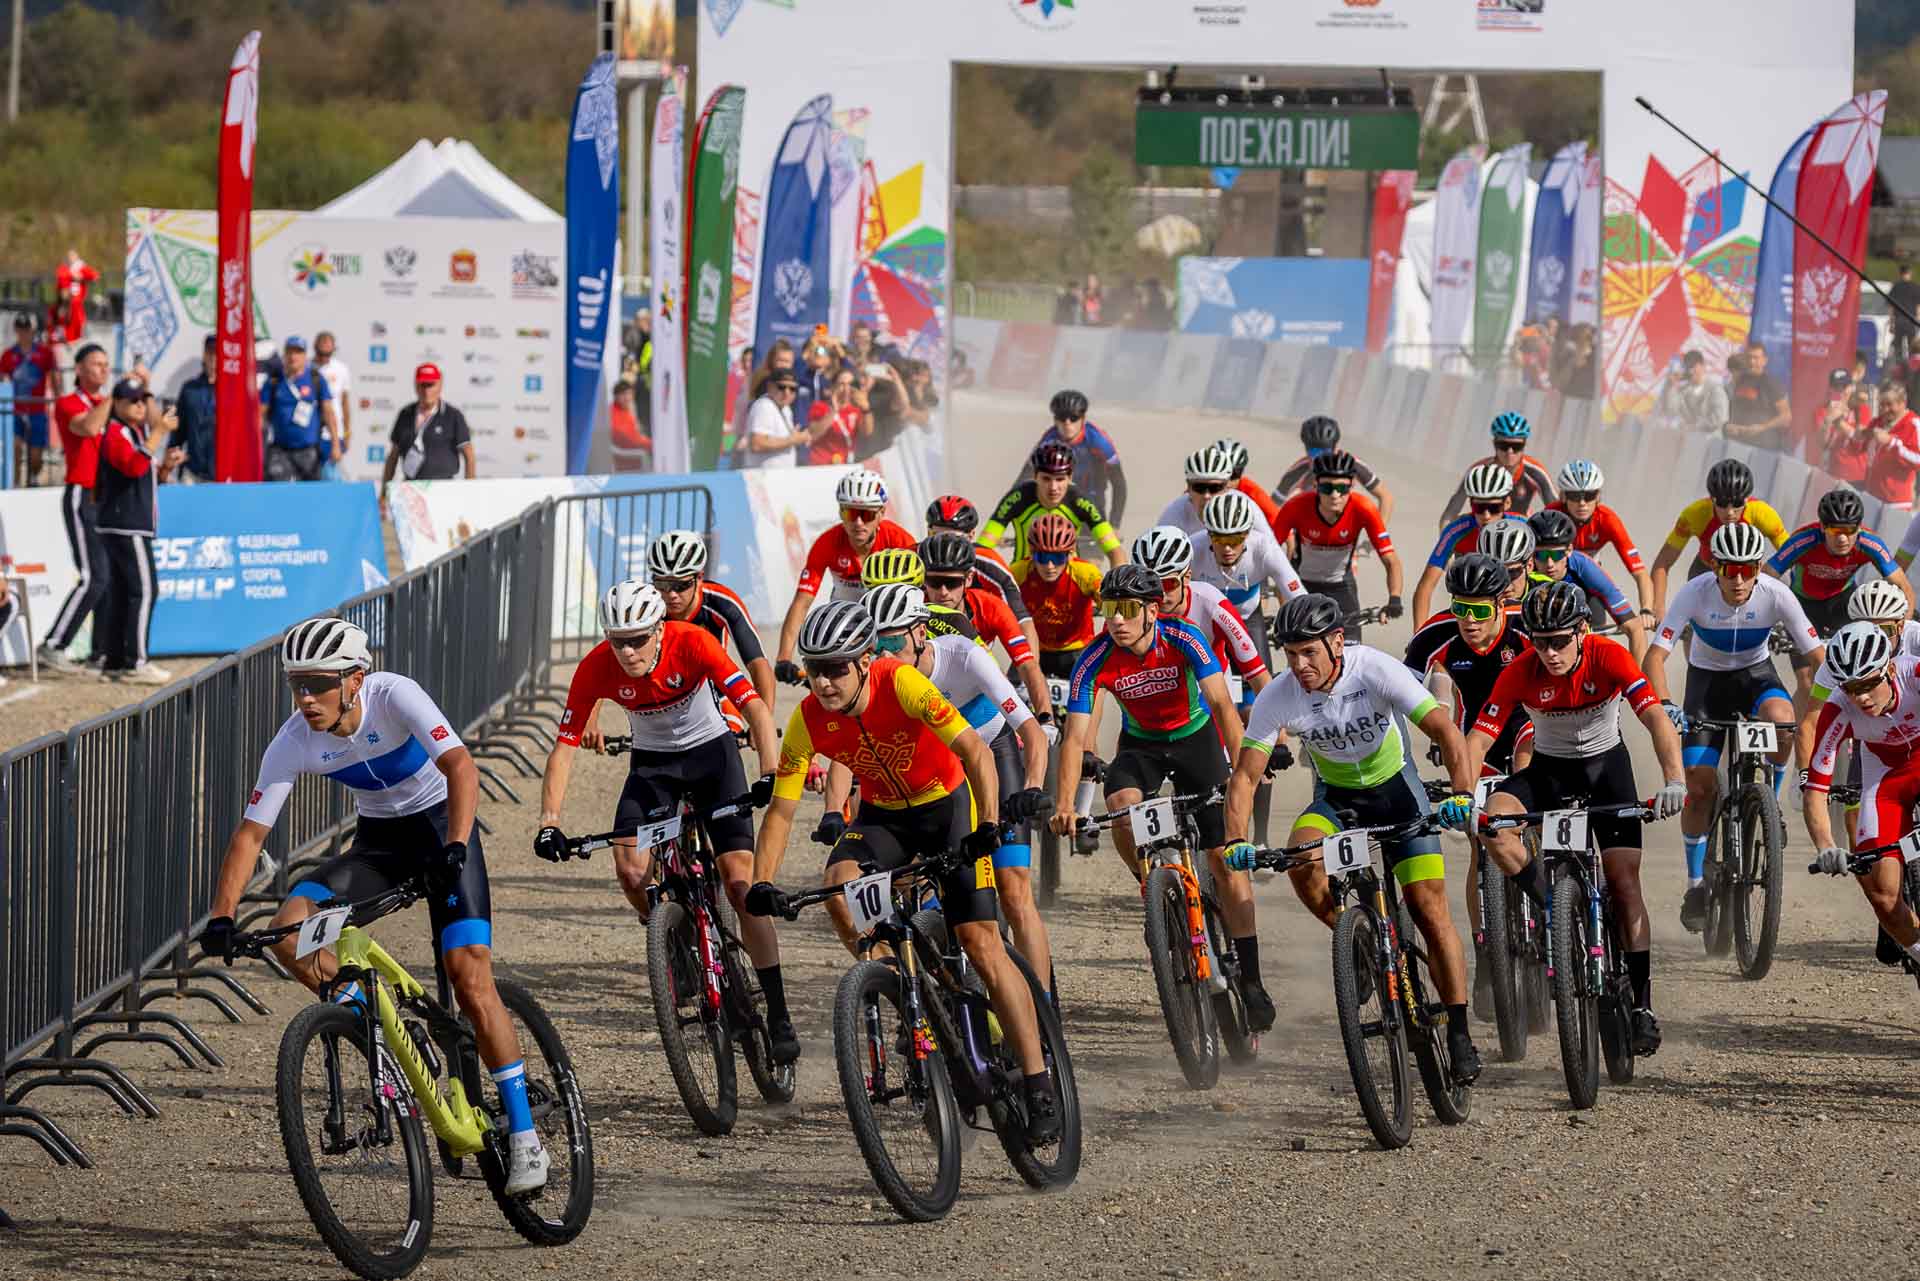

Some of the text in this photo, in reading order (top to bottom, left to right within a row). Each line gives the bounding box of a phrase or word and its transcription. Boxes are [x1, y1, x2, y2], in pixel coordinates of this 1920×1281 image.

[1201, 116, 1350, 166] ПОЕХАЛИ!
[240, 549, 329, 566] ВЕЛОСИПЕДНОГО
[242, 568, 282, 582] СПОРТА
[1114, 666, 1178, 691] MOSCOW
[1121, 679, 1178, 700] REGION
[1297, 711, 1386, 743] SAMARA
[1747, 727, 1769, 748] 21
[651, 827, 665, 844] 5
[1145, 808, 1160, 836] 3
[1557, 818, 1571, 845] 8
[1338, 836, 1354, 865] 6
[856, 883, 882, 921] 10
[312, 917, 328, 944] 4
